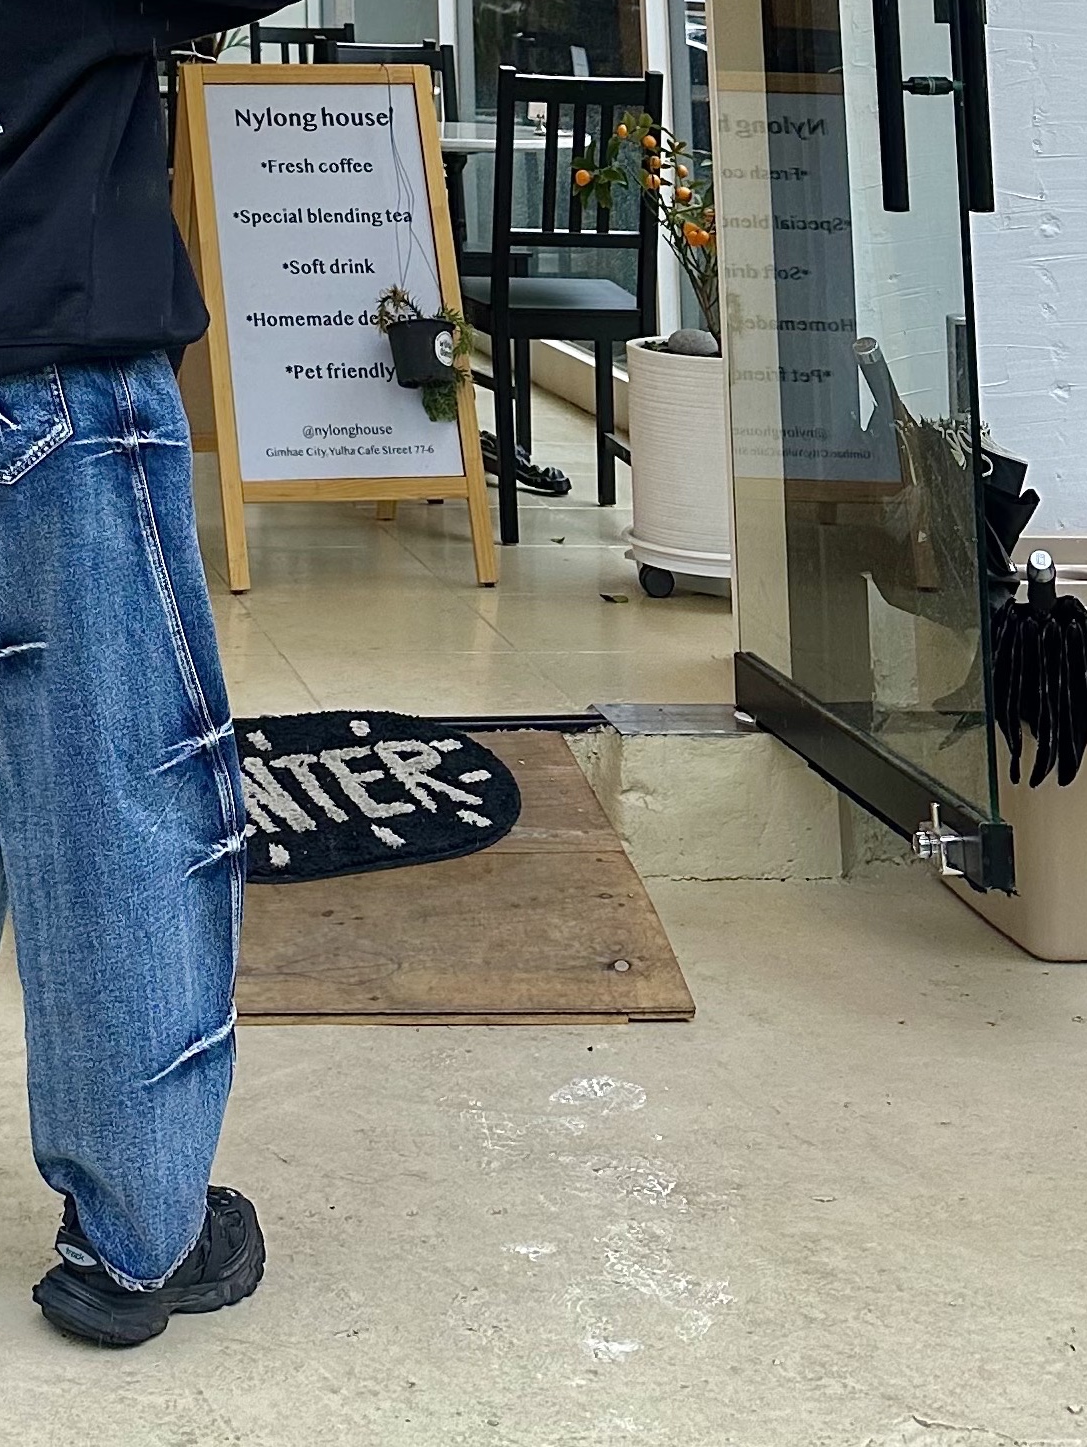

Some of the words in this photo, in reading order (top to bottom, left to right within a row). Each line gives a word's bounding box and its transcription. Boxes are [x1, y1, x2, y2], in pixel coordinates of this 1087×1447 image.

[234, 106, 318, 132] Nylong
[321, 106, 390, 127] house
[318, 158, 374, 173] coffee
[307, 208, 382, 227] blending
[386, 209, 413, 223] tea
[330, 259, 375, 274] drink
[327, 362, 395, 382] friendly
[302, 423, 393, 439] @nylonghouse
[241, 740, 483, 833] NTER
